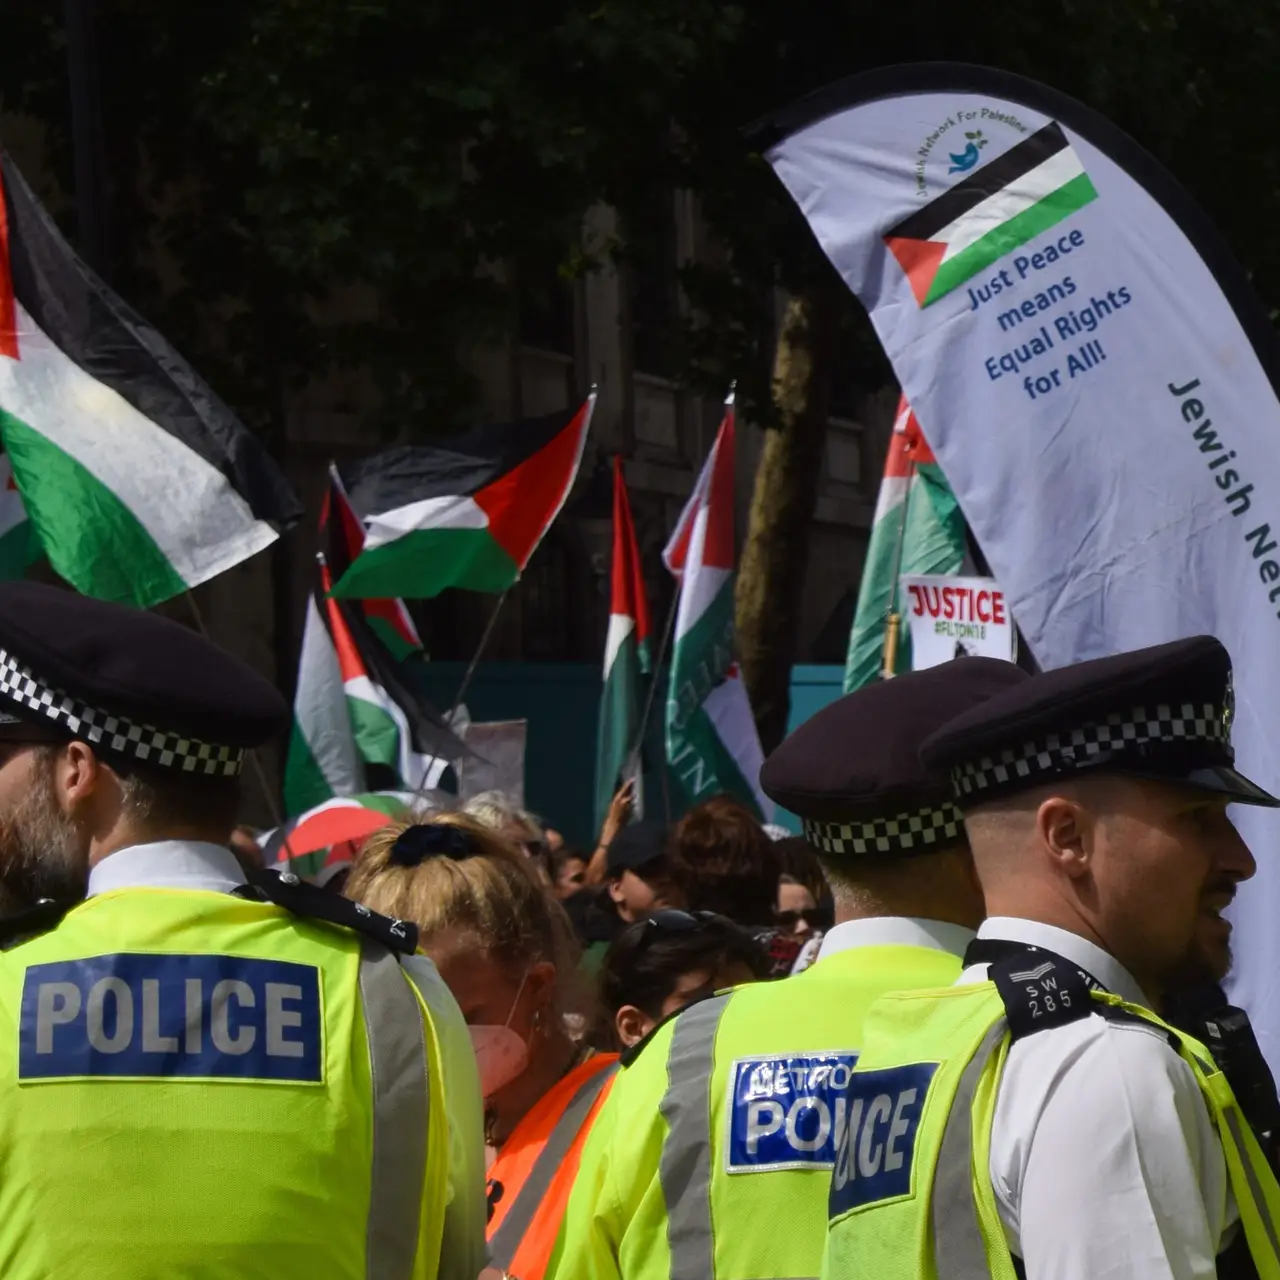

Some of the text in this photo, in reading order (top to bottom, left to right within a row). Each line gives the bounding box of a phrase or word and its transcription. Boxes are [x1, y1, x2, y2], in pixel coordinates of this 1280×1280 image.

[917, 116, 956, 157] Network
[956, 110, 977, 122] For
[980, 107, 1028, 133] Palestine
[967, 228, 1085, 312] Just Peace
[984, 285, 1132, 381] Equal Rights
[996, 275, 1077, 332] means
[1023, 338, 1107, 400] for All!
[1167, 378, 1255, 518] Jewish
[907, 584, 1007, 626] JUSTICE
[35, 976, 304, 1058] POLICE
[1028, 989, 1072, 1018] 285
